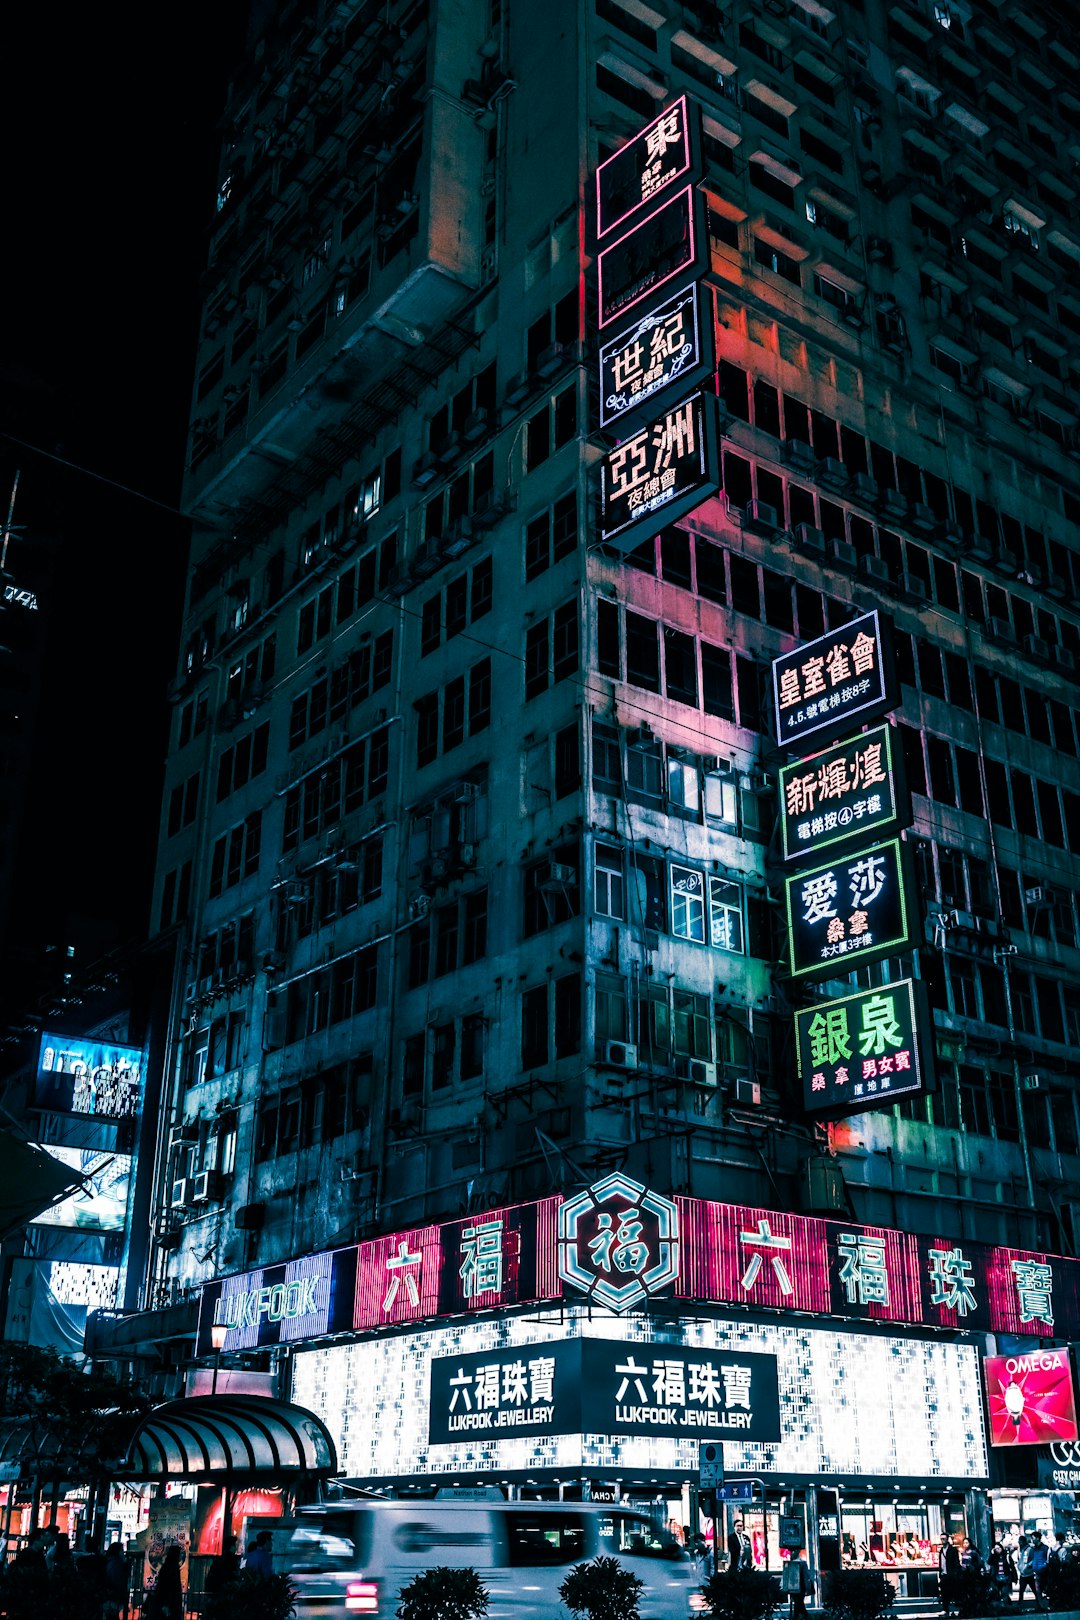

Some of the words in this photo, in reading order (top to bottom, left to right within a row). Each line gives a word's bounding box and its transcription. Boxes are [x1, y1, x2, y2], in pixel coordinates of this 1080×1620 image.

[611, 311, 686, 393] 世紀
[609, 402, 695, 502] 亞洲
[627, 468, 677, 511] 夜總會
[779, 631, 875, 709] 皇室雀會
[786, 743, 887, 816] 新輝煌
[801, 856, 886, 925] 愛莎
[826, 910, 869, 944] 桑拿
[807, 995, 905, 1069] 銀泉
[811, 1066, 850, 1092] 桑拿
[862, 1050, 912, 1080] 男女賓
[382, 1220, 504, 1312] 六福
[587, 1208, 651, 1275] 福
[739, 1219, 1056, 1326] 六福珠寶
[213, 1275, 319, 1330] LUKFOOK
[448, 1356, 556, 1413] 六福珠寶
[615, 1356, 752, 1410] 六福珠寶
[1005, 1353, 1064, 1375] OMEGA
[448, 1410, 493, 1432] LUKFOOK
[493, 1406, 555, 1427] JEWELLERY
[615, 1405, 678, 1425] LUKFOOK
[680, 1409, 753, 1429] JEWELLERY
